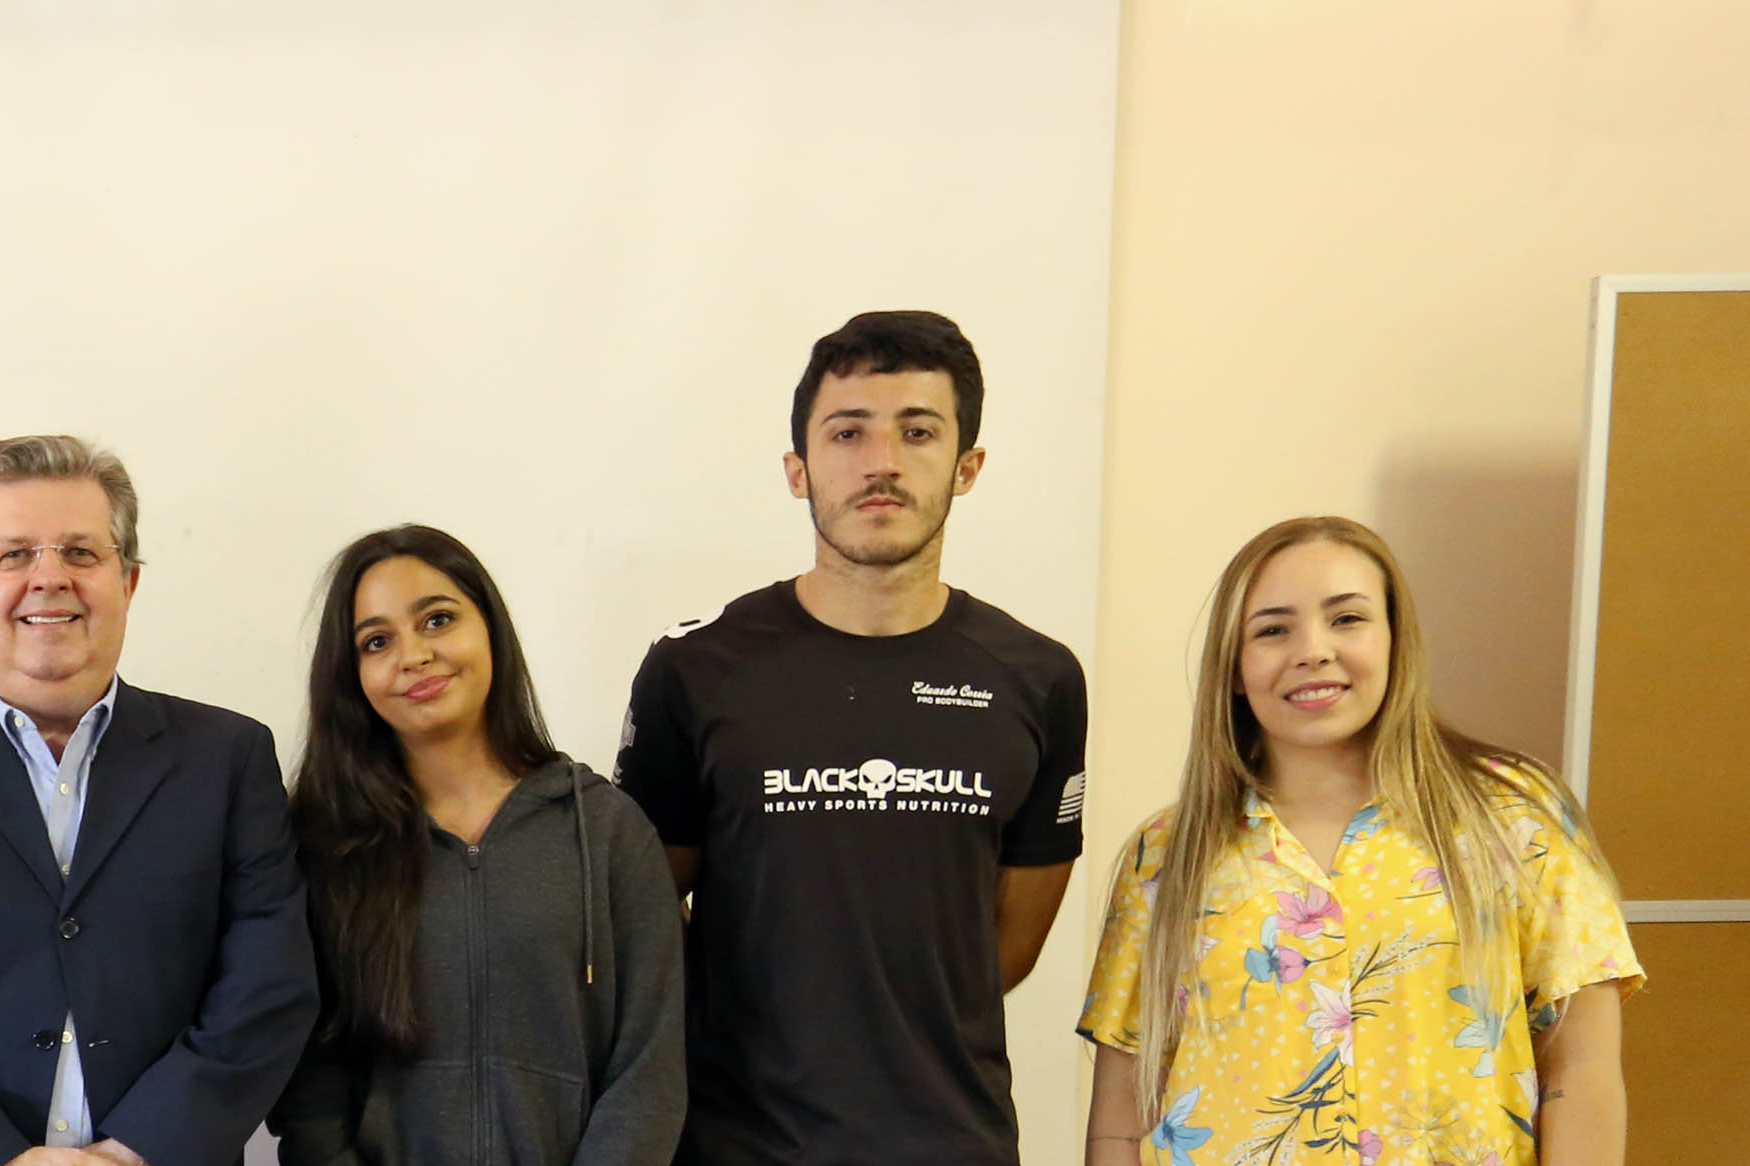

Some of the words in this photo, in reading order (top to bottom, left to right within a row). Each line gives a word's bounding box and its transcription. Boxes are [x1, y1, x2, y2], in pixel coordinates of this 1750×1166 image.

[916, 695, 933, 705] PRO
[935, 696, 989, 708] BODYBUILDER
[763, 768, 858, 794] BLACK
[896, 768, 992, 798] SKULL
[764, 800, 817, 813] HEAVY
[824, 800, 888, 811] SPORTS
[896, 800, 990, 816] NUTRITION
